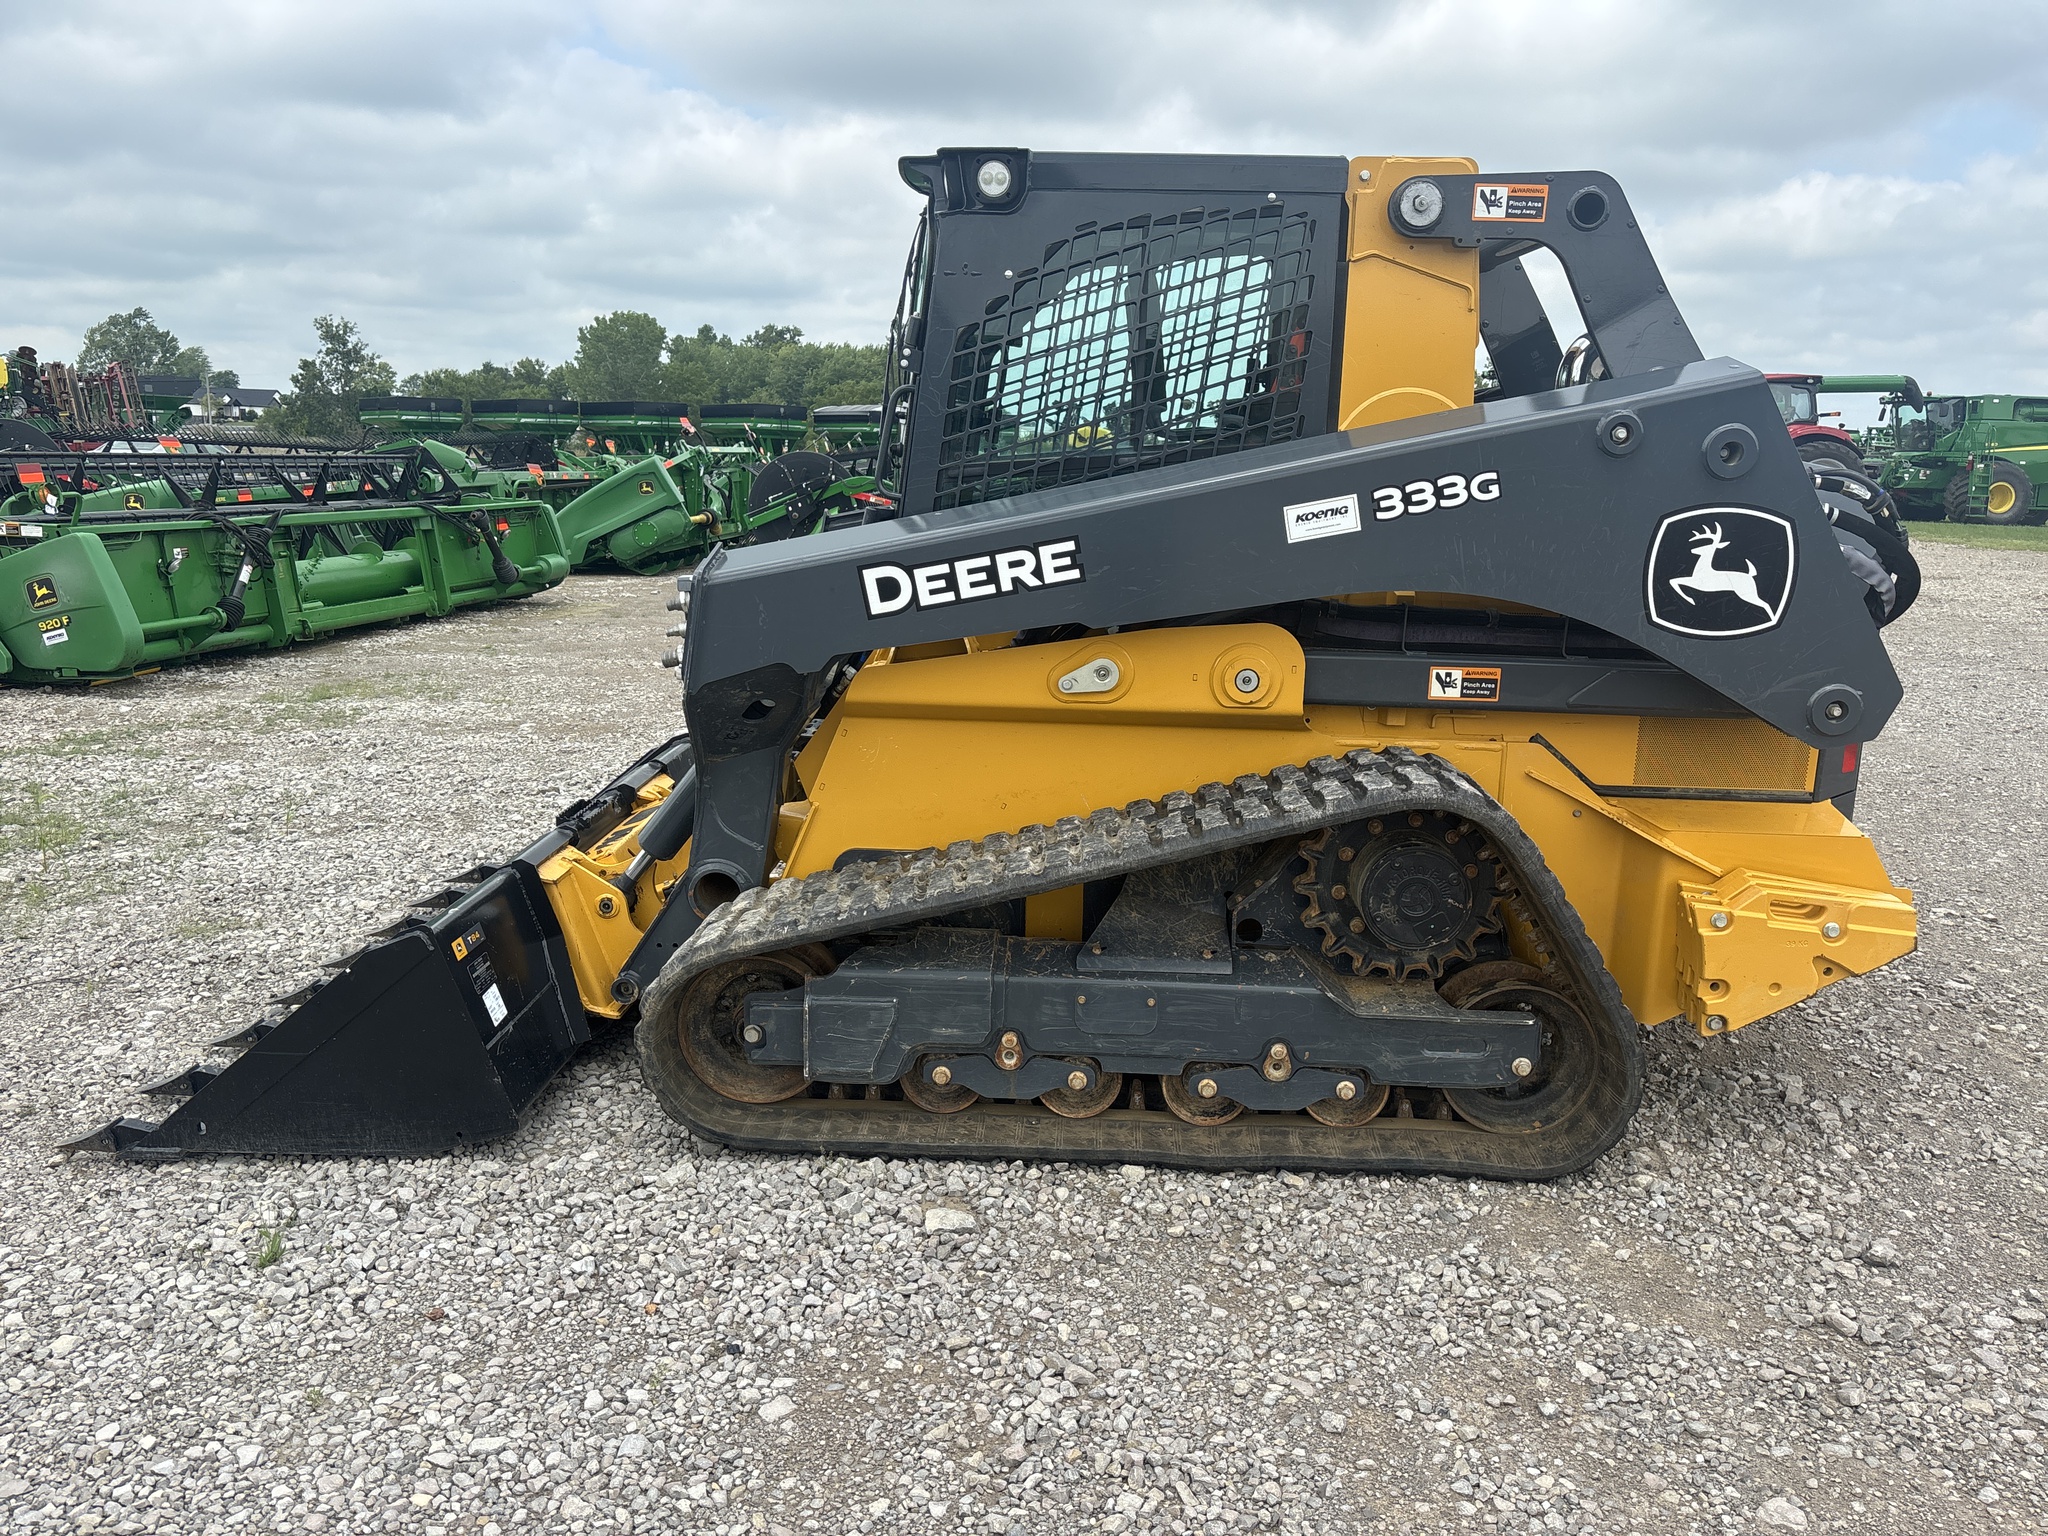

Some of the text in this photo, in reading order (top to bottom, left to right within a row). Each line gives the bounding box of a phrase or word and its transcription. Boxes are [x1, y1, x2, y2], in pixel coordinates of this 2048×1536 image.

[1372, 471, 1501, 521] 333G
[861, 540, 1081, 615] DEERE
[38, 616, 70, 631] 920 F
[466, 931, 481, 945] T84
[1797, 940, 1809, 948] KG
